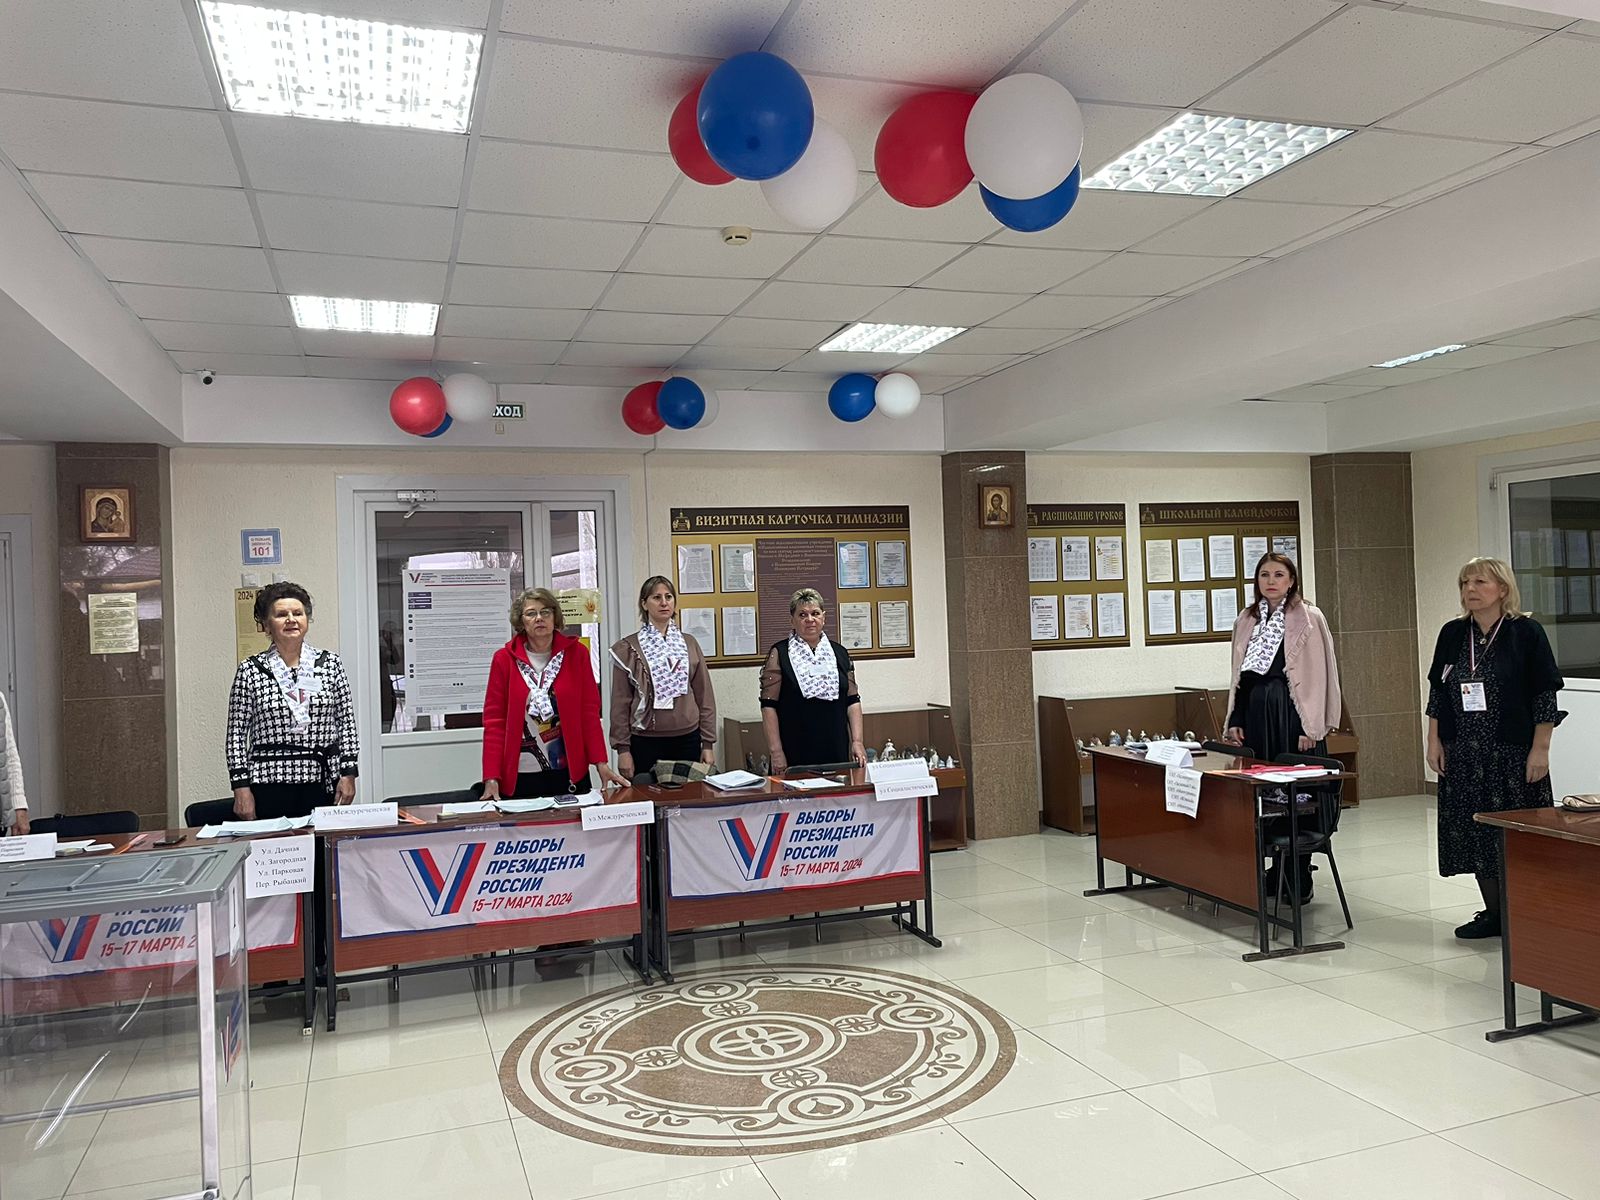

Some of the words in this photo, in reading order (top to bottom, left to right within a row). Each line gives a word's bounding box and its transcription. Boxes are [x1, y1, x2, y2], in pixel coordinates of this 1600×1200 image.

[695, 515, 765, 526] ВИЗИТНАЯ
[767, 514, 833, 525] КАРТОЧКА
[836, 513, 903, 524] ГИМНАЗИИ
[1041, 511, 1094, 521] РАСПИСАНИЕ
[1095, 510, 1124, 523] УРОКОВ
[1159, 508, 1221, 520] ШКОЛЬНЫЙ
[1223, 506, 1297, 519] КАЛЕЙДОСКОП
[252, 546, 270, 556] 101
[237, 591, 254, 600] 2024
[796, 808, 856, 825] ВЫБОРЫ
[789, 823, 874, 843] ПРЕЗИДЕНТА
[274, 845, 300, 855] Дачная
[493, 838, 565, 856] ВЫБОРЫ
[783, 844, 839, 861] РОССИИ
[268, 856, 307, 867] Загородная
[485, 854, 586, 875] ПРЕЗИДЕНТА
[806, 860, 840, 874] МАРТА
[841, 857, 864, 871] 2024
[272, 867, 304, 877] Парковая
[255, 880, 271, 889] Пер.
[273, 877, 307, 887] Рыбацкий
[478, 877, 544, 895] РОССИИ
[504, 895, 545, 910] МАРТА
[545, 892, 573, 907] 2024
[106, 917, 185, 938] РОССИИ
[138, 935, 186, 954] МАРТА
